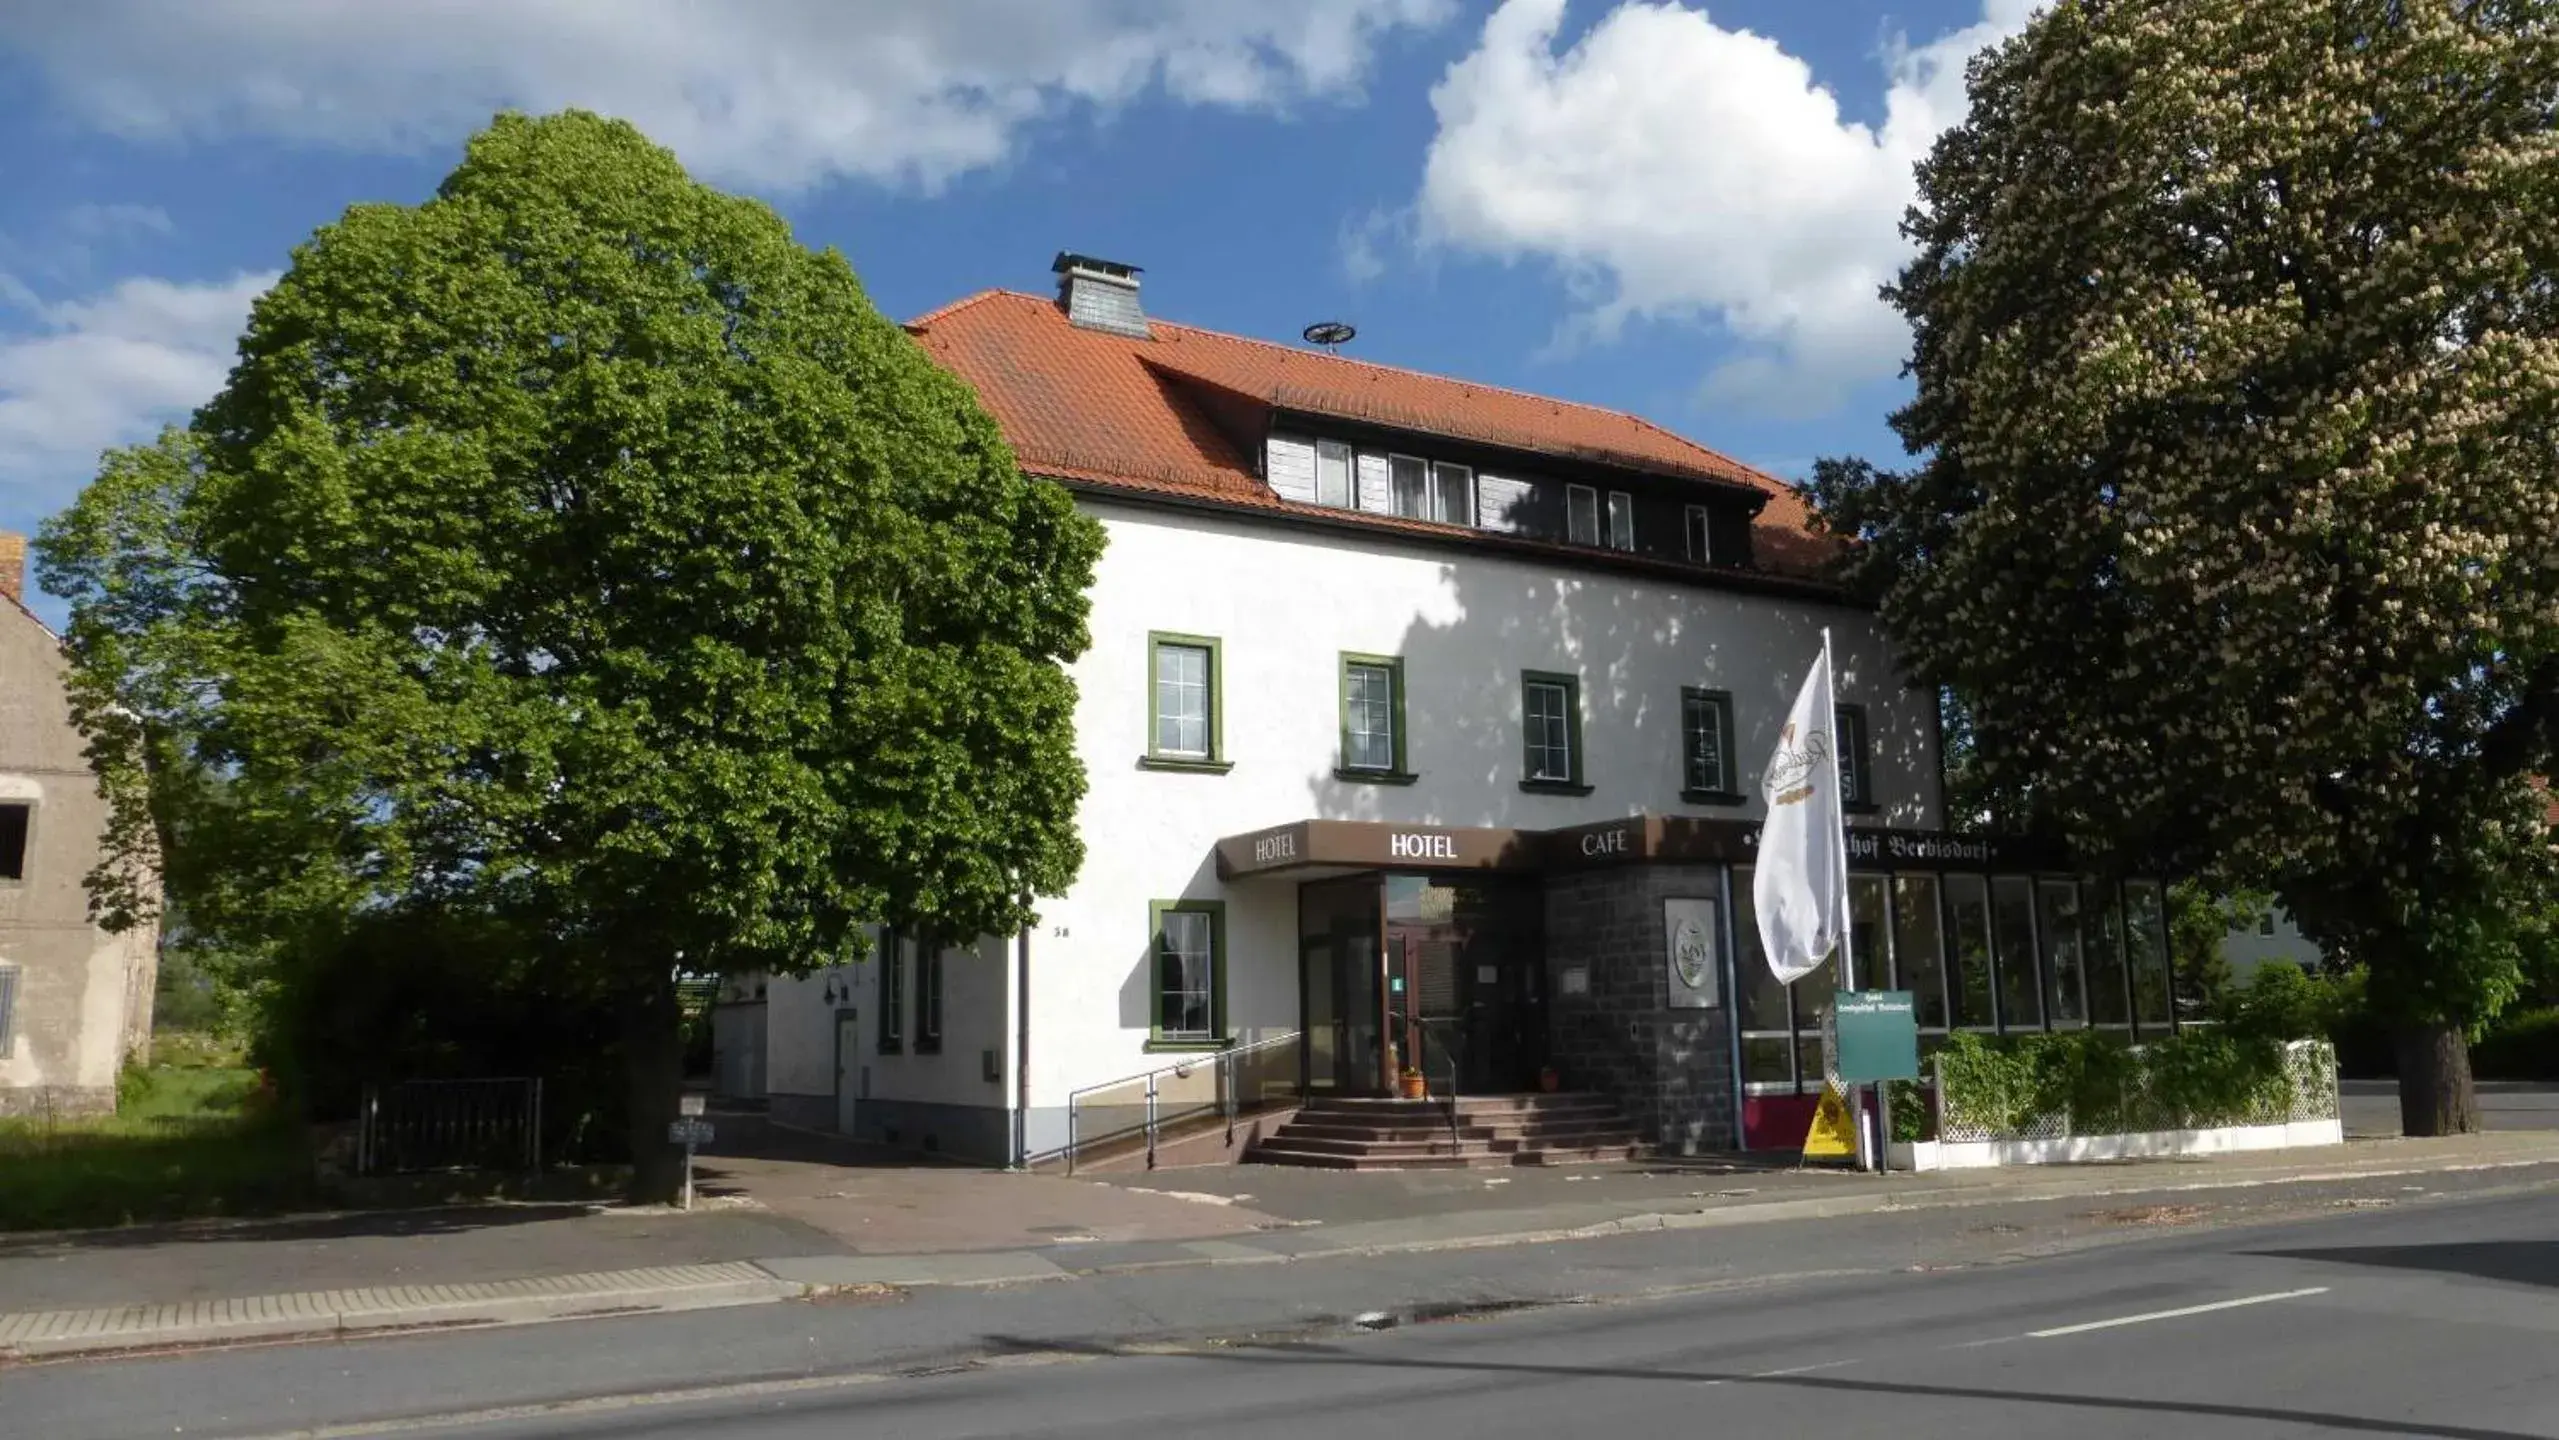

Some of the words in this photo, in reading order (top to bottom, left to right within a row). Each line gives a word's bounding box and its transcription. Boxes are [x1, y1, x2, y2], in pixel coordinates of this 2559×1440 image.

[1256, 832, 1296, 861] HOTEL
[1391, 833, 1458, 859] HOTEL
[1582, 829, 1629, 856] CAFE
